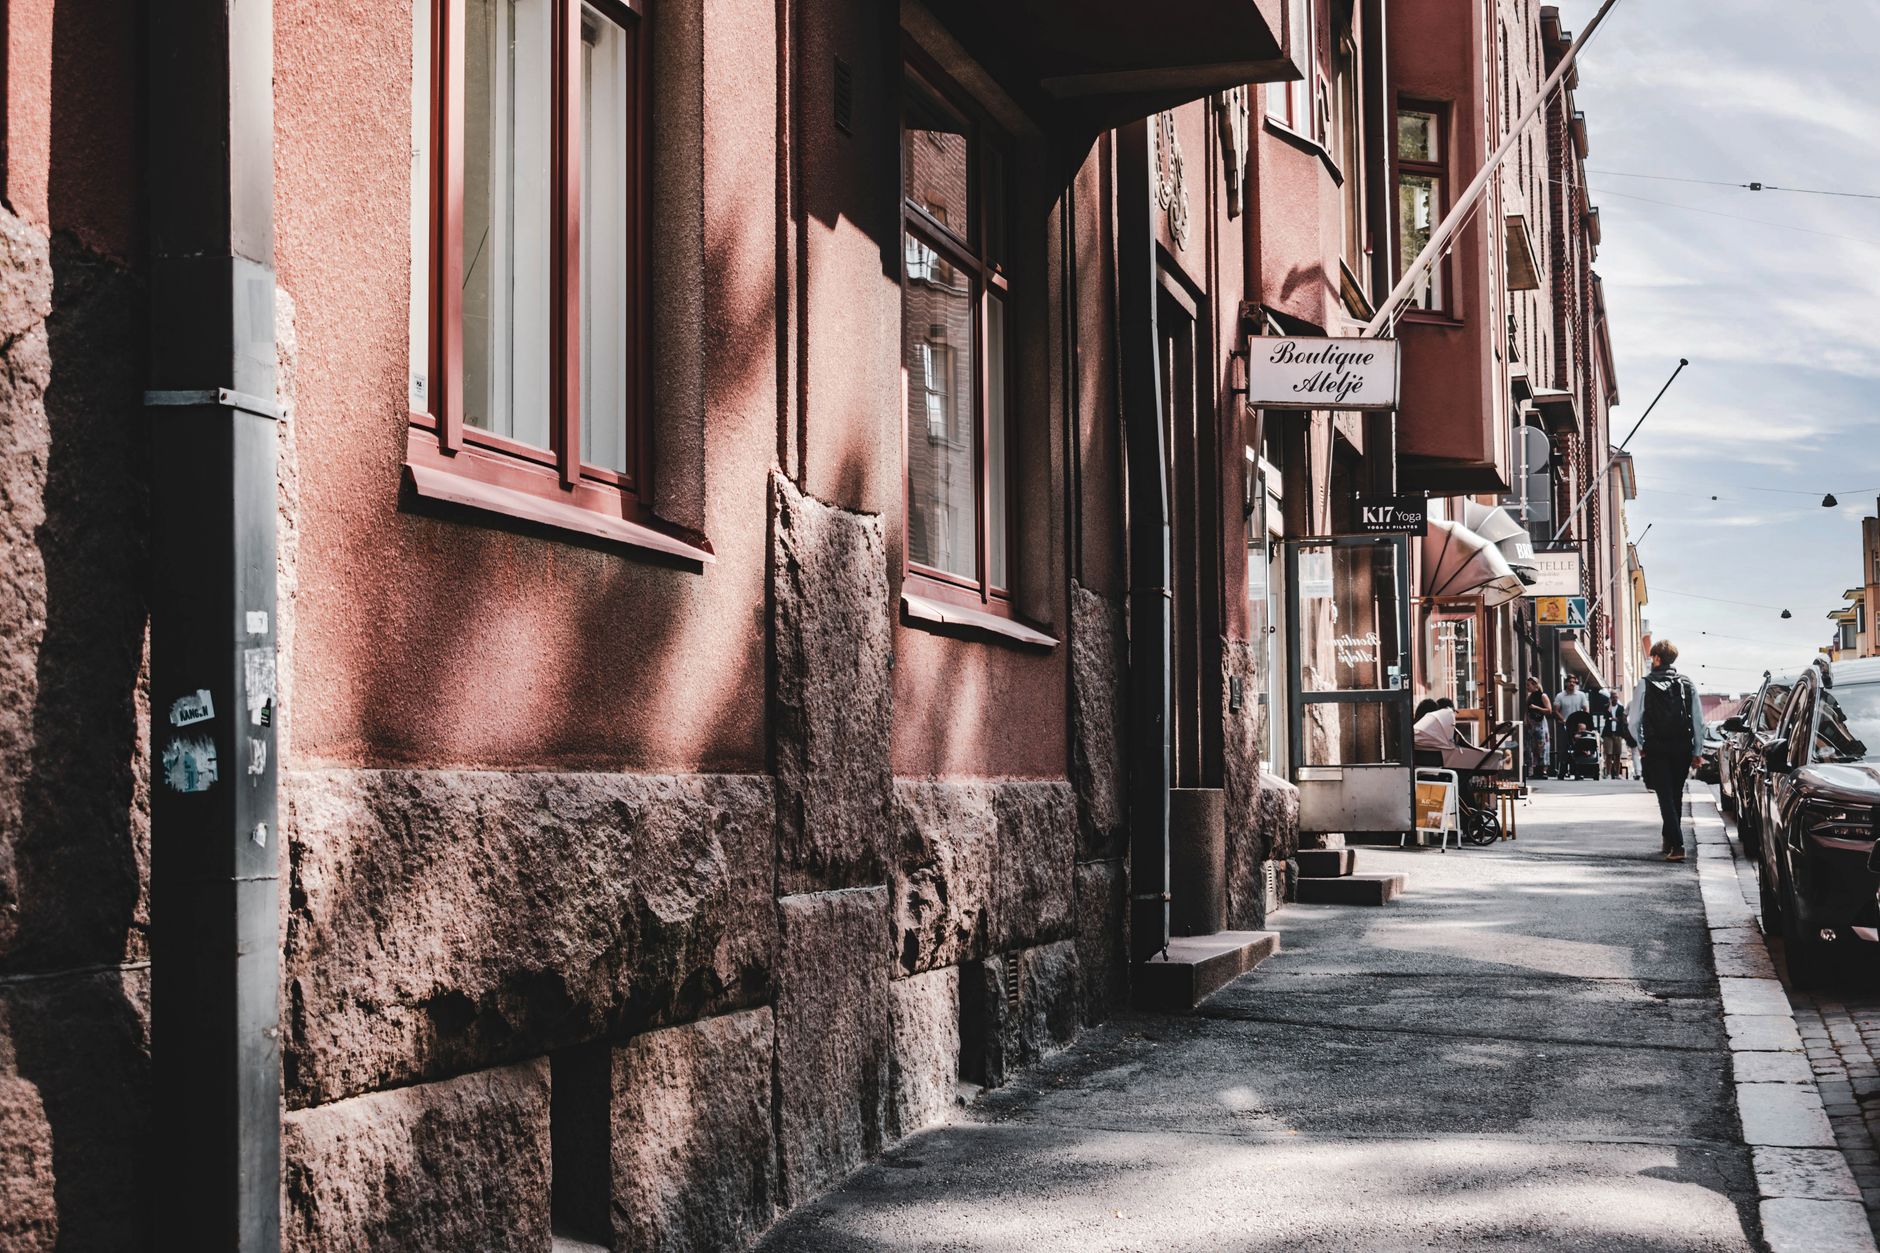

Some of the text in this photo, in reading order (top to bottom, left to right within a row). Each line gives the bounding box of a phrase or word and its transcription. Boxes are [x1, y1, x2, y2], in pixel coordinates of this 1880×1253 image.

[1269, 341, 1375, 374] Boutique
[1292, 370, 1364, 403] Ateljé
[1362, 506, 1422, 523] K17 Yoga
